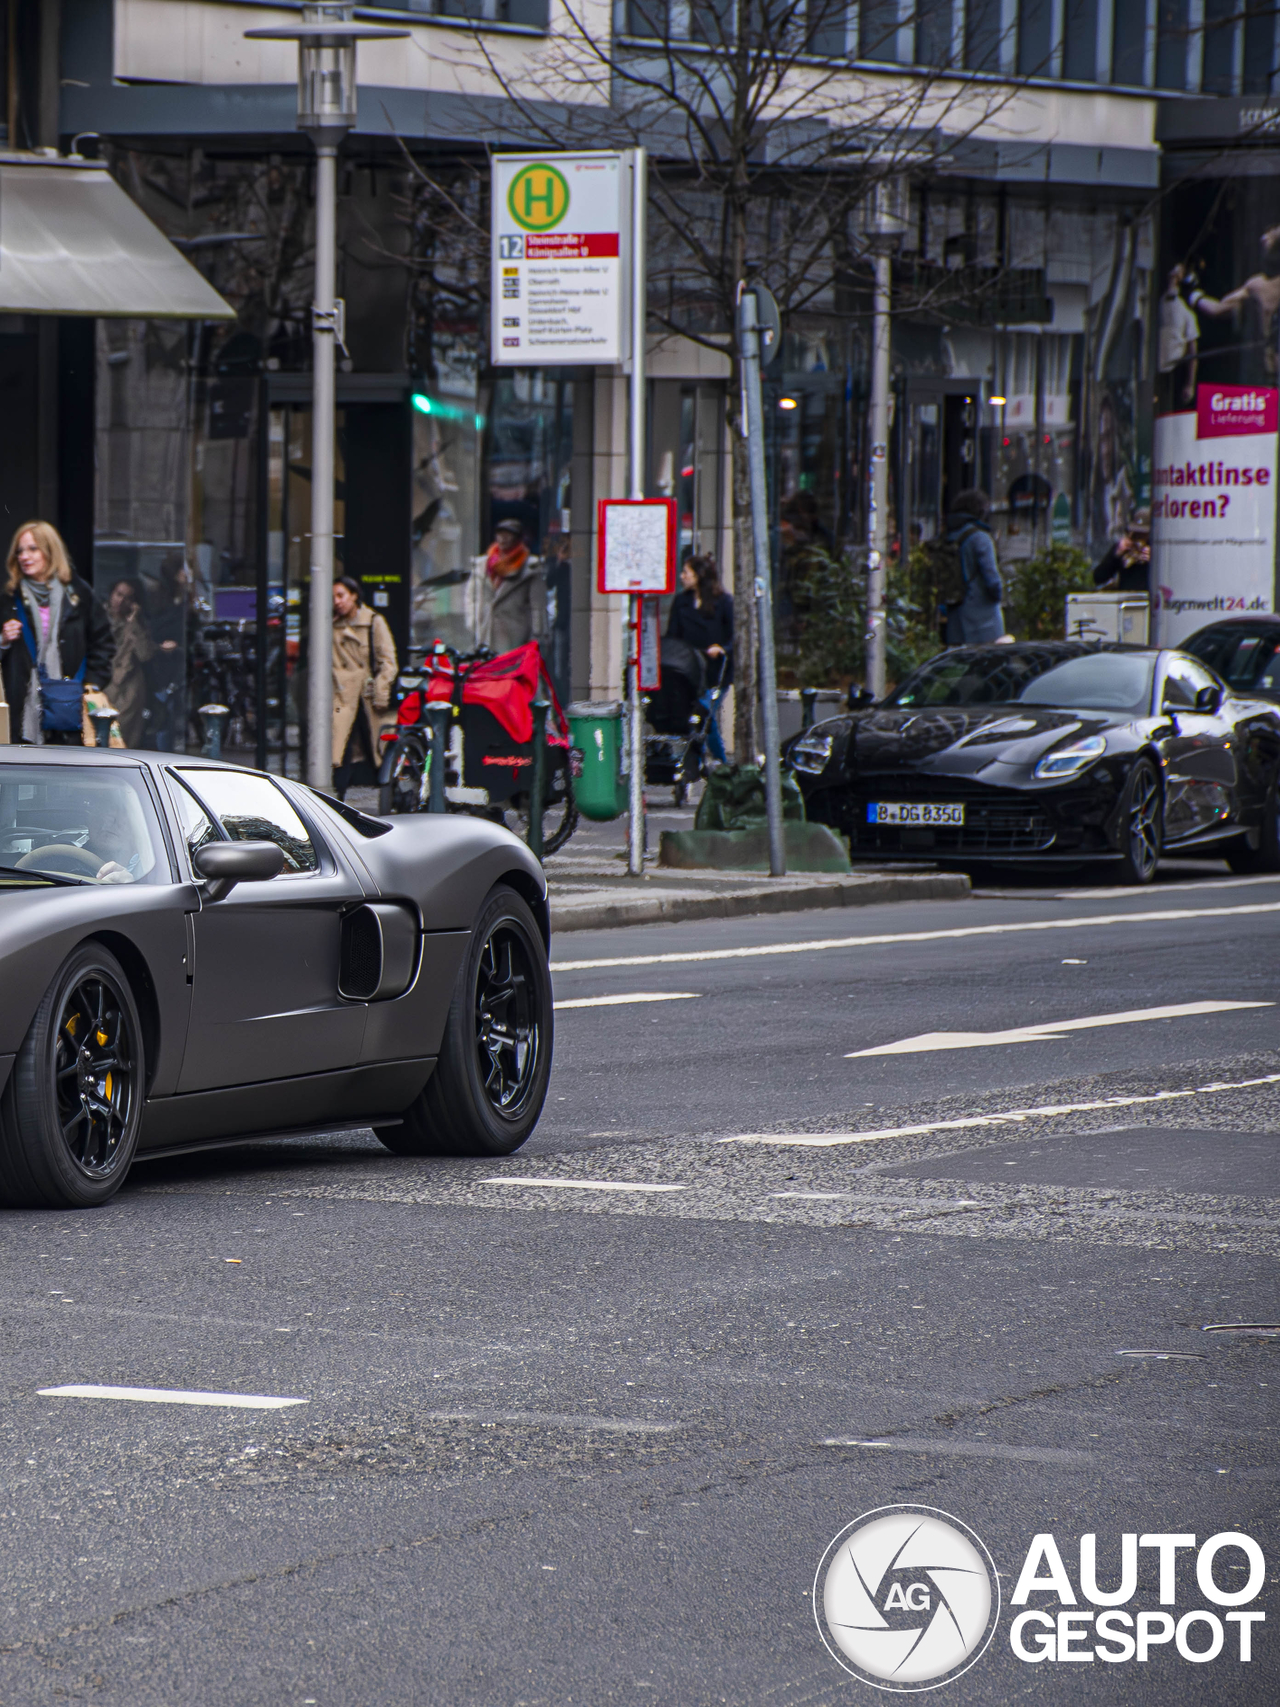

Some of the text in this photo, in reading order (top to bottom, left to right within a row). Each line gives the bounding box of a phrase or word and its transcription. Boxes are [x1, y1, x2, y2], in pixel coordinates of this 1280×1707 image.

[524, 176, 555, 219] H
[500, 236, 524, 259] 12
[528, 234, 580, 246] Steinstraße
[528, 246, 590, 260] Königsallee U
[922, 805, 962, 823] 8350
